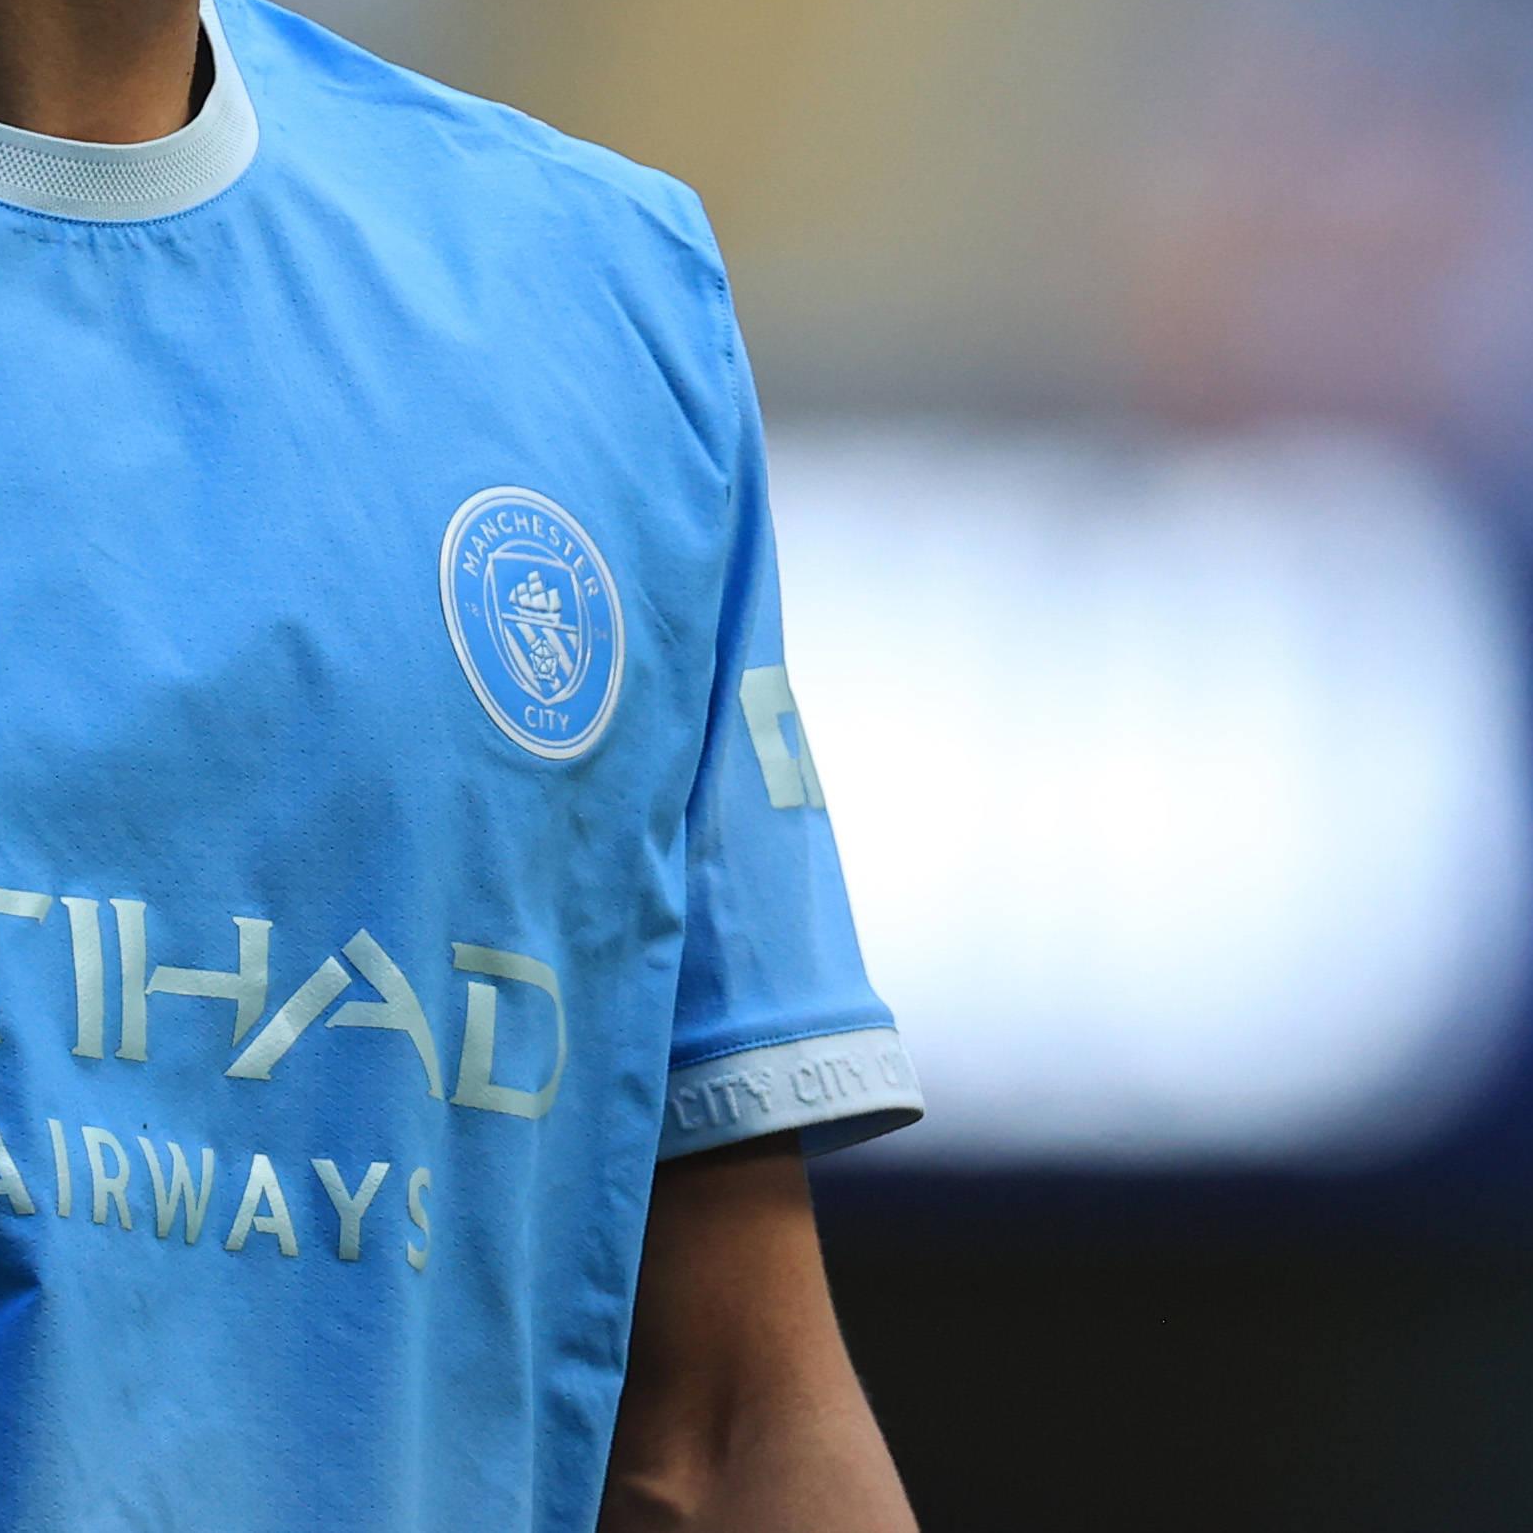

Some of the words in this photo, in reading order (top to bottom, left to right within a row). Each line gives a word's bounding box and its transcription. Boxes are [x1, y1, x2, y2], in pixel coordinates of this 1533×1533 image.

[463, 512, 599, 597] MANCHESTER
[524, 706, 570, 732] CITY
[672, 1069, 771, 1132] CITY
[790, 1055, 867, 1107] CITY
